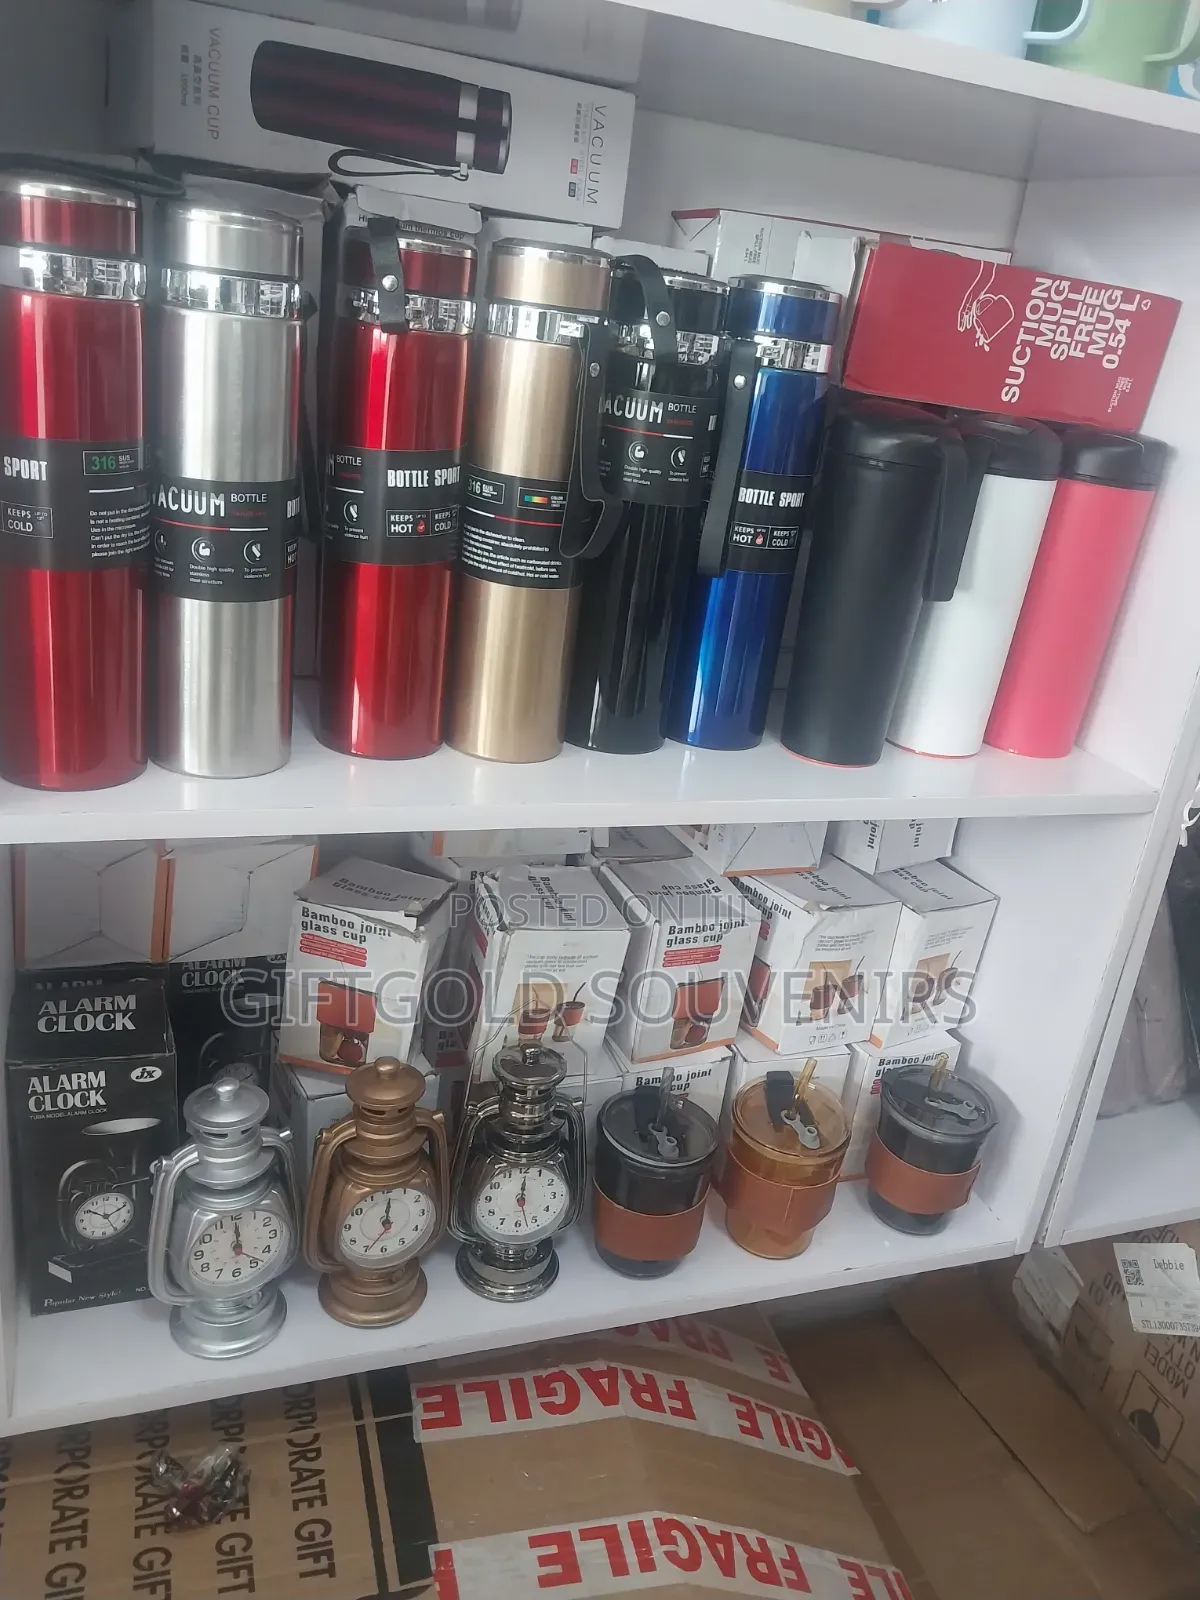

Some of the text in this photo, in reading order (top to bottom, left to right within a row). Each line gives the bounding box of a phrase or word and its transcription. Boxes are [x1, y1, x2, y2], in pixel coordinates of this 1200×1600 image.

[207, 26, 221, 140] VACUUM CUP
[586, 105, 607, 204] VACUUM
[1034, 280, 1071, 347] MUG
[1050, 285, 1088, 361] SPILL
[1068, 287, 1105, 359] FREE
[1087, 289, 1123, 355] MUG
[1102, 294, 1140, 369] 0.54 L
[1000, 277, 1053, 403] SUCTION
[668, 402, 697, 413] BOTTLE
[91, 456, 116, 471] 316
[336, 454, 362, 466] BOTTLE
[3, 456, 48, 481] SPORT
[387, 466, 461, 488] BOTTLE SPORT
[468, 478, 480, 494] 316
[230, 493, 267, 503] BOTTLE
[738, 487, 805, 507] BOTTLE SPORT
[7, 507, 31, 519] KEEPS
[434, 511, 451, 520] KEEPS
[7, 519, 33, 532] COLD
[390, 524, 413, 533] HOT
[434, 521, 452, 531] COLD
[733, 534, 753, 543] HOT
[867, 821, 879, 849] joint
[913, 823, 922, 848] joint
[339, 878, 392, 897] Bamboo
[810, 881, 828, 892] cup
[828, 886, 852, 899] joint
[910, 881, 928, 893] cup
[301, 906, 355, 929] Bamboo
[757, 905, 773, 920] cup
[769, 900, 792, 920] joint
[301, 919, 367, 944] glass cup
[668, 919, 746, 936] Bamboo joint
[666, 932, 723, 948] glass cup
[181, 957, 246, 970] ALARM
[181, 969, 245, 988] CLOCK
[38, 994, 137, 1016] ALARM
[37, 1011, 136, 1034] CLOCK
[878, 1057, 919, 1067] Bamboo
[636, 1068, 712, 1086] Bamo joint
[875, 1067, 894, 1077] gla
[27, 1070, 106, 1095] ALARM
[670, 1082, 690, 1092] cup
[28, 1089, 107, 1113] CLOCK
[503, 1170, 512, 1179] 11
[489, 1181, 500, 1190] 10
[350, 1207, 363, 1216] 10
[215, 1220, 224, 1230] 11
[262, 1217, 272, 1227] 2
[199, 1233, 213, 1245] 10
[268, 1229, 278, 1239] 3
[194, 1250, 204, 1260] 9
[262, 1245, 271, 1254] 4
[200, 1262, 210, 1272] 8
[249, 1260, 259, 1269] 5
[1152, 1258, 1185, 1271] Debbie
[215, 1268, 224, 1279] 7
[231, 1268, 242, 1278] 6
[43, 1298, 76, 1308] Popular
[99, 1289, 122, 1299] Style!
[415, 1364, 697, 1431] FRAGILE
[726, 1393, 857, 1470] GILE
[293, 1518, 338, 1579] GIFT
[527, 1516, 812, 1594] FRAGILE
[214, 1532, 257, 1596] GIFT
